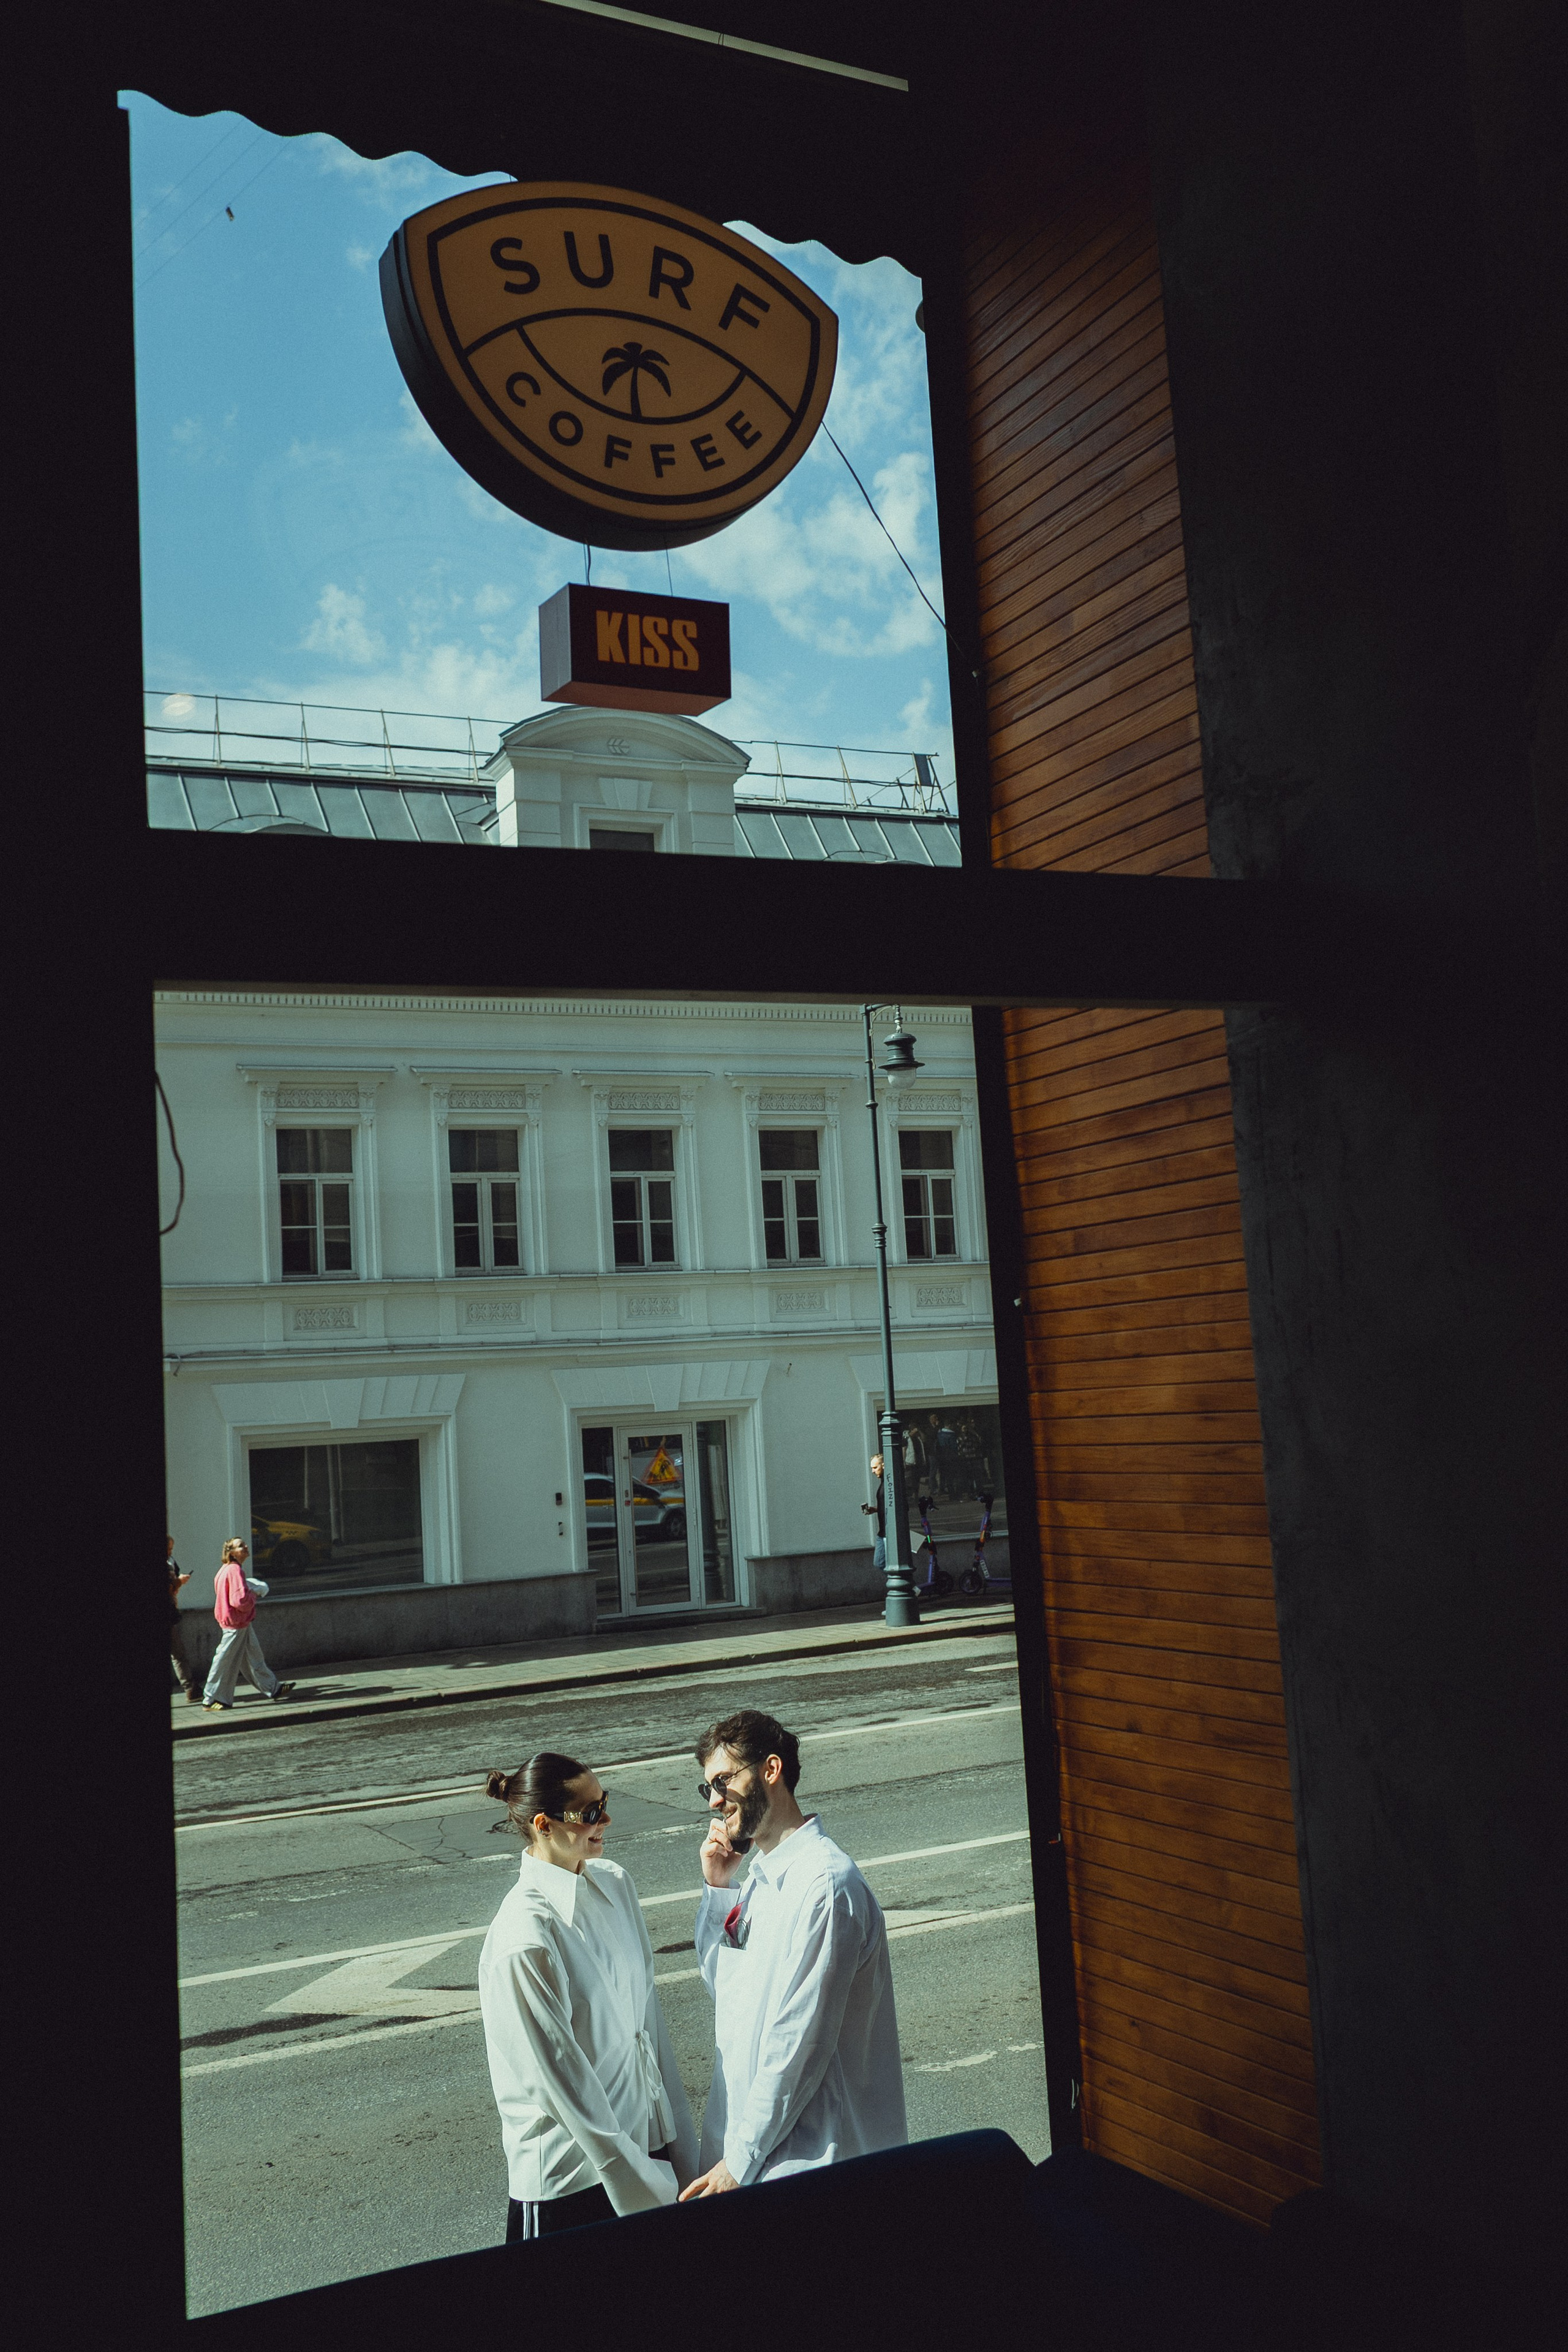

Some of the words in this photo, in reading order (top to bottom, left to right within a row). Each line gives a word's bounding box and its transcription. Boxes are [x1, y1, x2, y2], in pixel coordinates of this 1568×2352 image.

[489, 230, 771, 332] SURF
[505, 370, 763, 478] COFFEE
[595, 609, 699, 671] KISS
